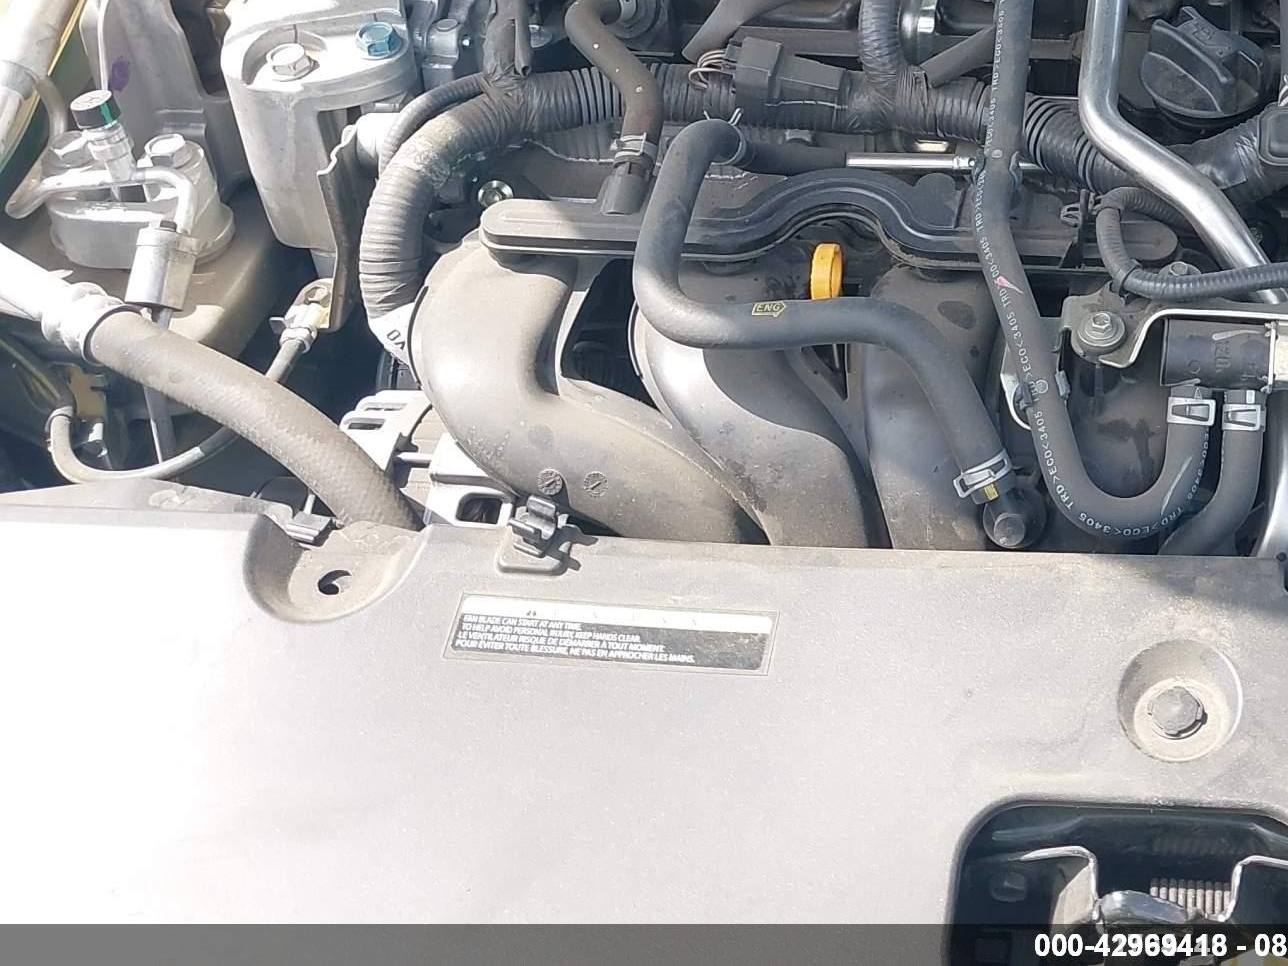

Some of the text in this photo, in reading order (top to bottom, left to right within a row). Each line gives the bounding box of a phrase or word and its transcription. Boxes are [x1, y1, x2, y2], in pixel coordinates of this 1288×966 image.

[756, 304, 780, 312] ENG
[502, 617, 517, 626] CAN
[538, 620, 549, 628] AT
[472, 624, 491, 632] HELP
[512, 626, 548, 636] PERSONAL
[455, 640, 478, 648] POUR
[457, 631, 468, 639] LE
[468, 632, 518, 642] VENTILATEUR
[608, 642, 629, 650] TOUT
